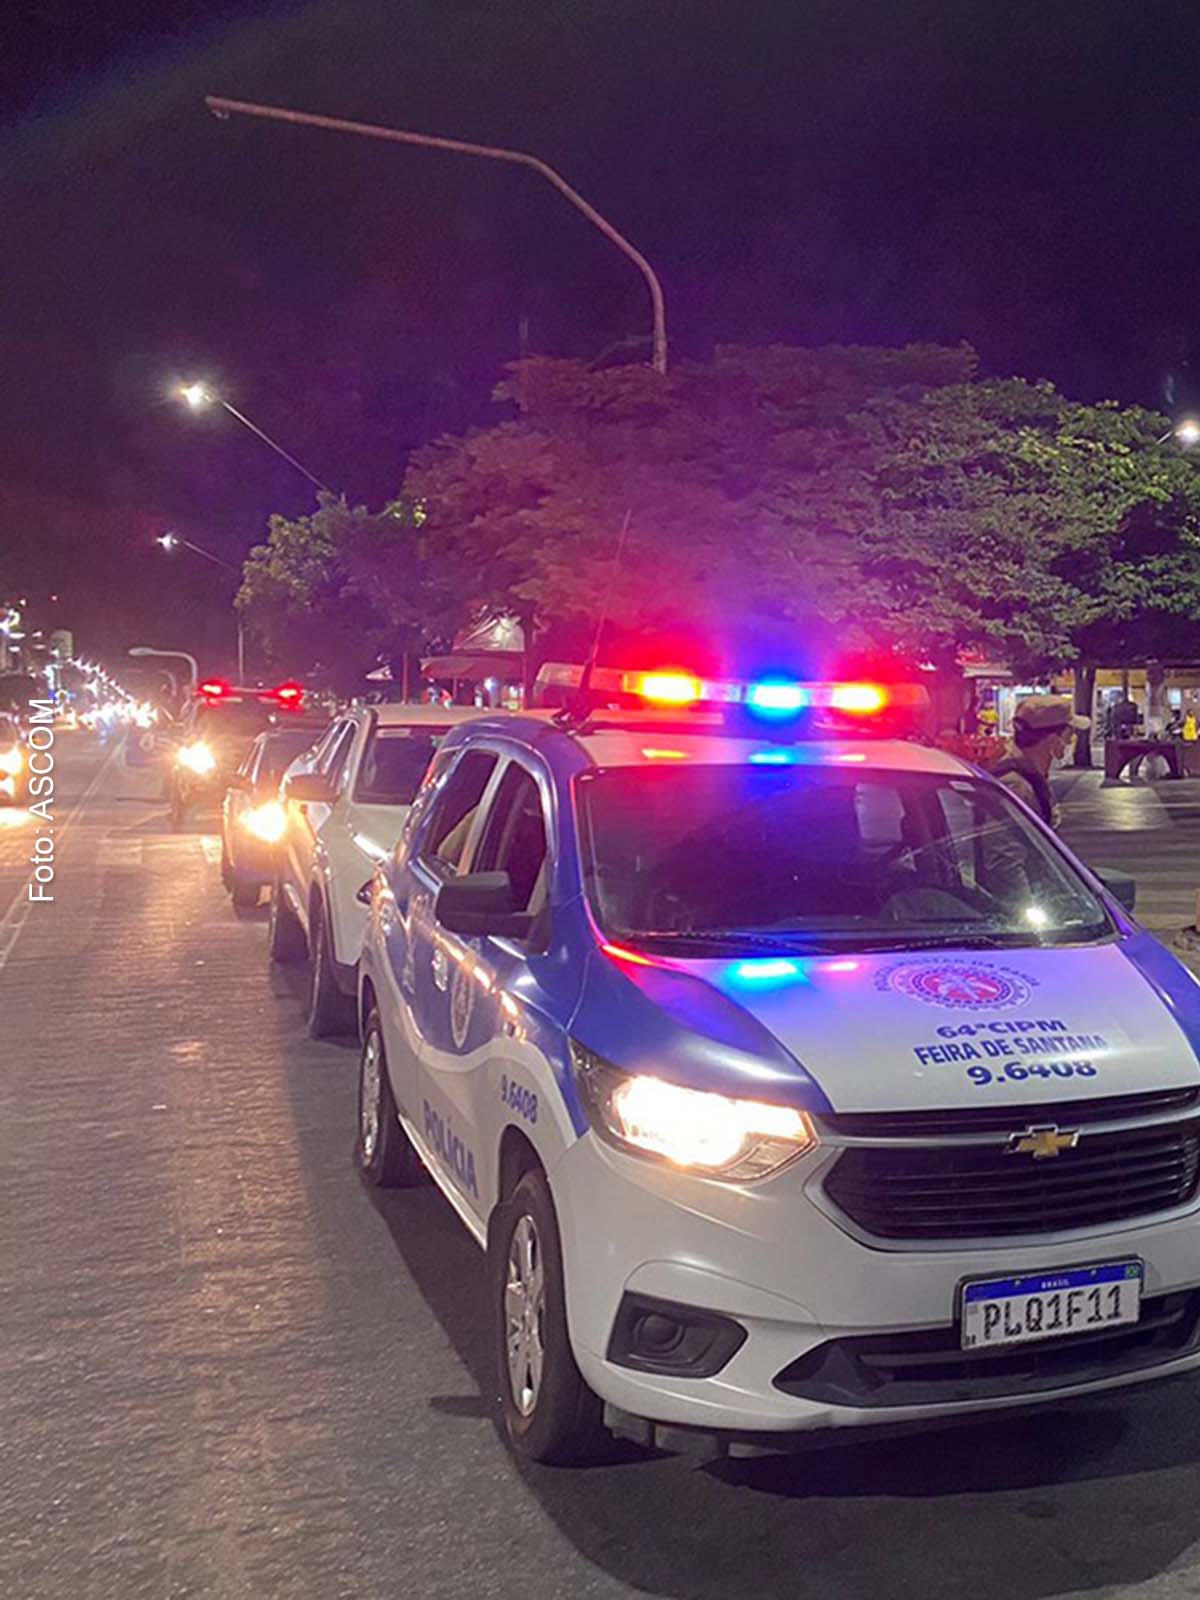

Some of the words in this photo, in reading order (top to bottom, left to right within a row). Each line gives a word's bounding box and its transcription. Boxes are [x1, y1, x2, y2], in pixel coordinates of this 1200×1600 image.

[914, 1042, 982, 1066] FEIRA
[980, 1038, 1015, 1058] DE
[1013, 1035, 1106, 1055] SANTANA
[966, 1060, 1098, 1086] 9.6408
[501, 1073, 538, 1124] 9.6408
[983, 1284, 1124, 1341] PLQ1F11
